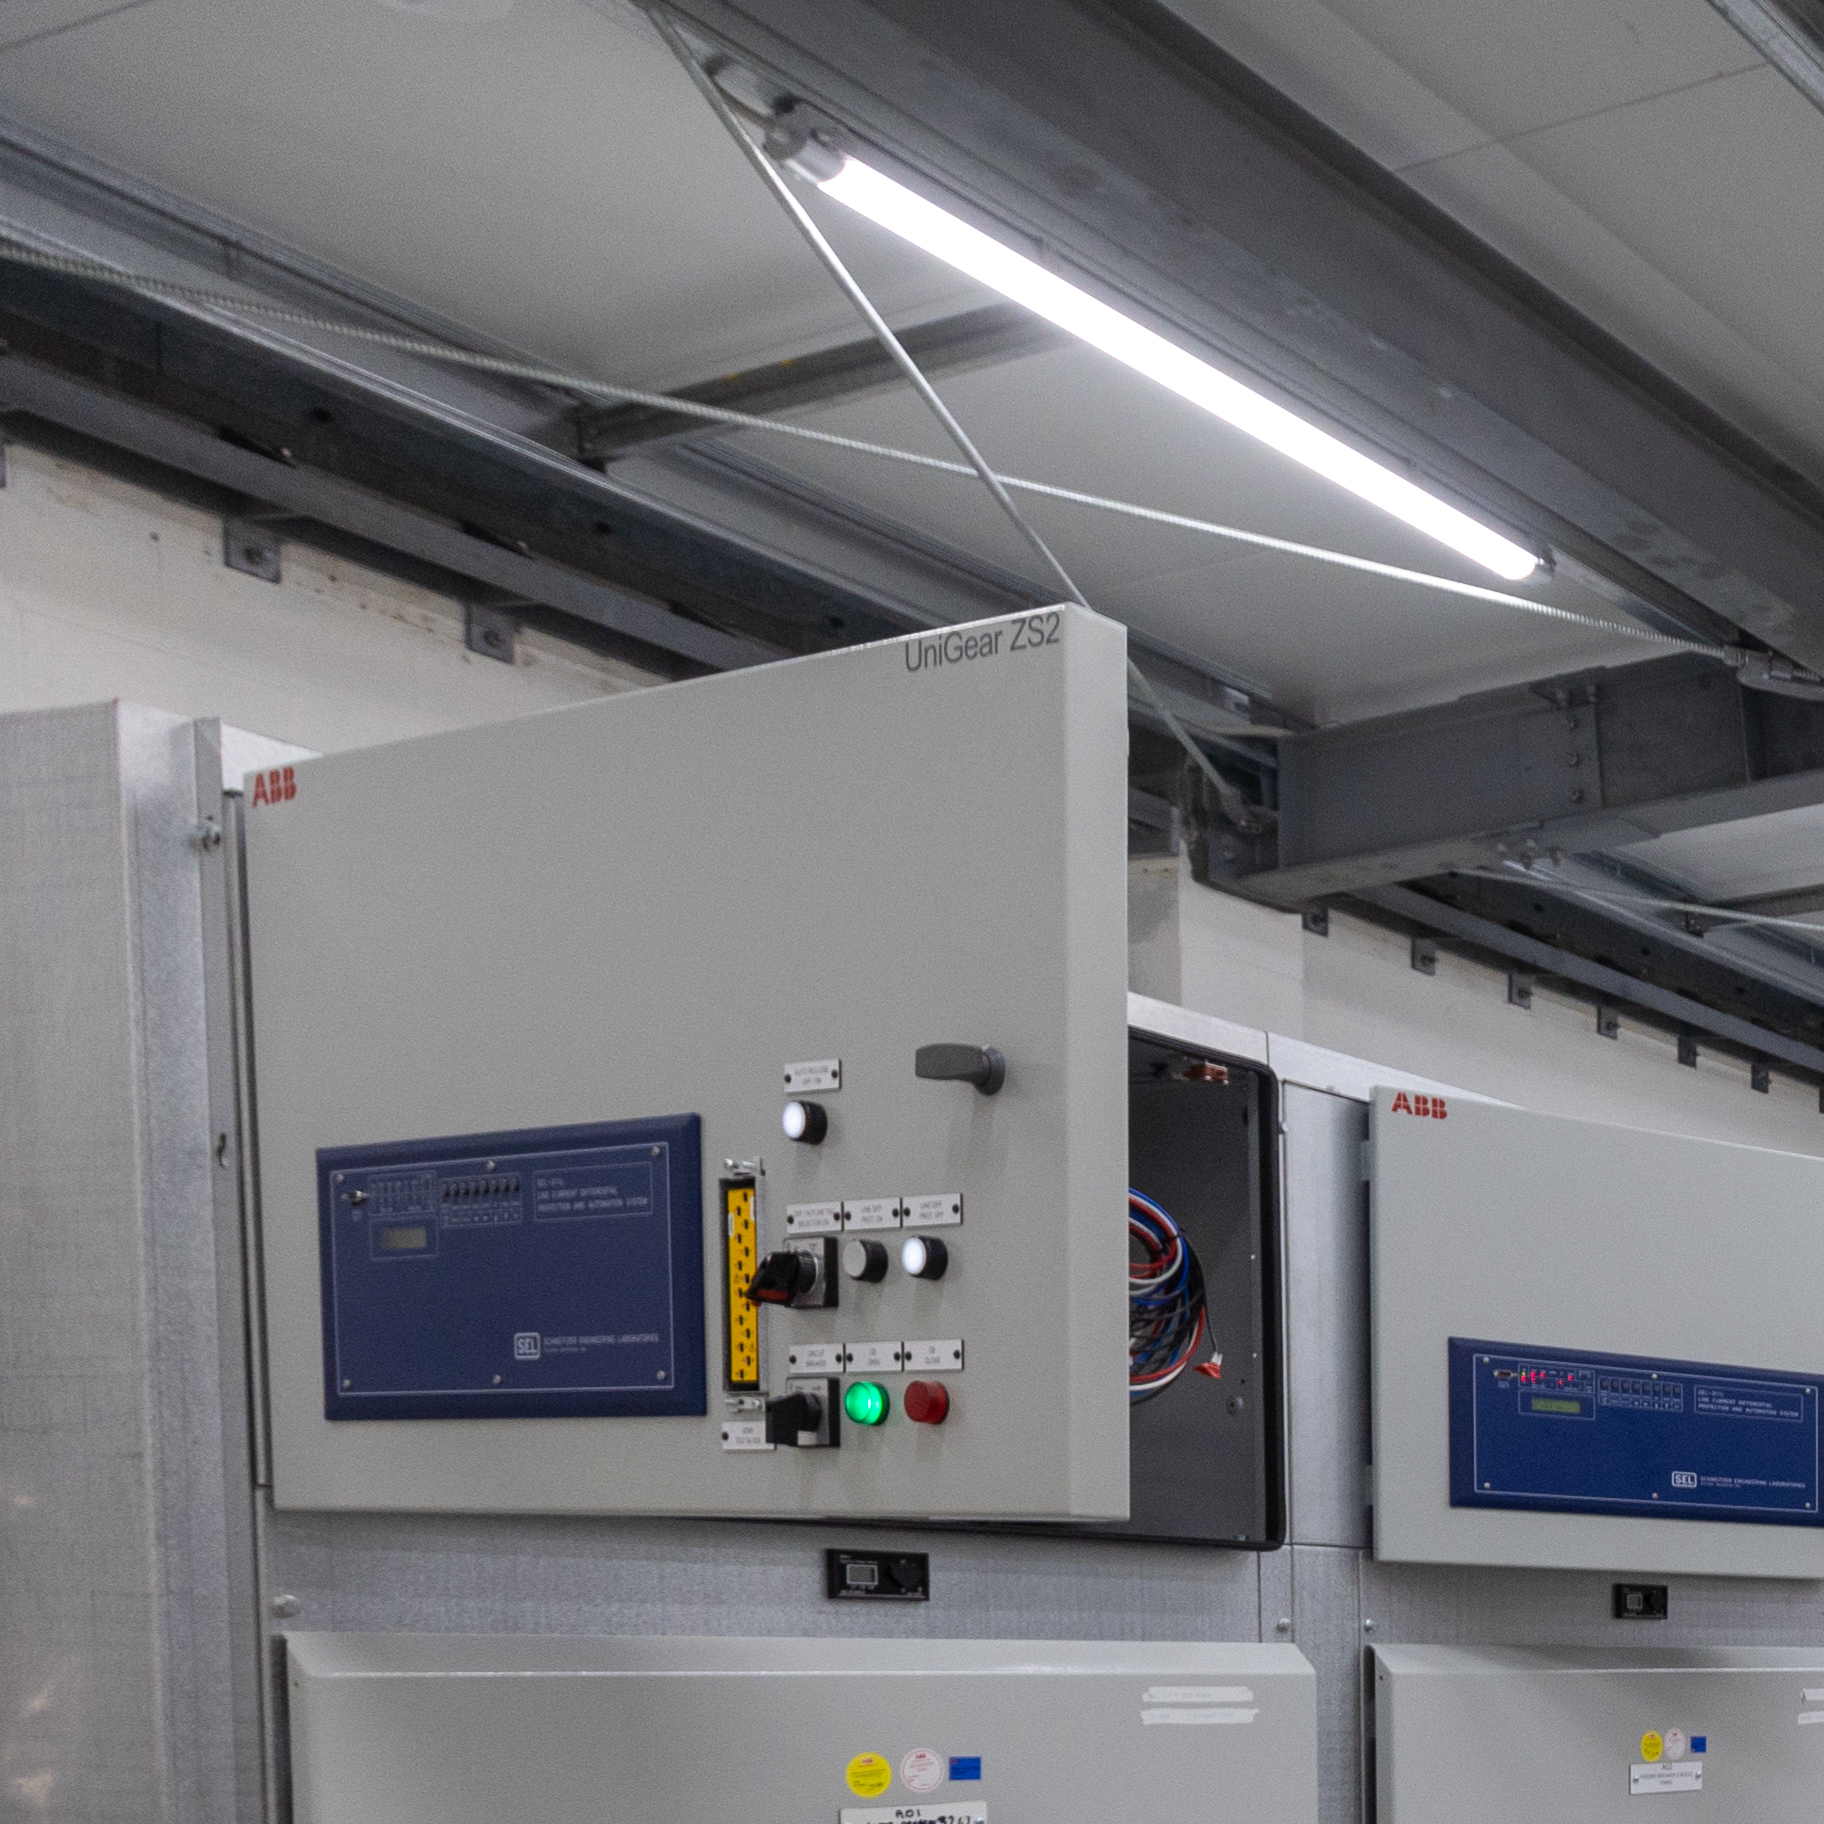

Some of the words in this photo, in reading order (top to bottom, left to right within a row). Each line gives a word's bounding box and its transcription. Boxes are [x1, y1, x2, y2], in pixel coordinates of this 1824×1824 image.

[905, 627, 1002, 671] UniGear
[1009, 613, 1061, 652] ZS2
[253, 766, 297, 806] ABB
[1391, 1091, 1448, 1119] ABB
[1675, 1474, 1695, 1485] SEL
